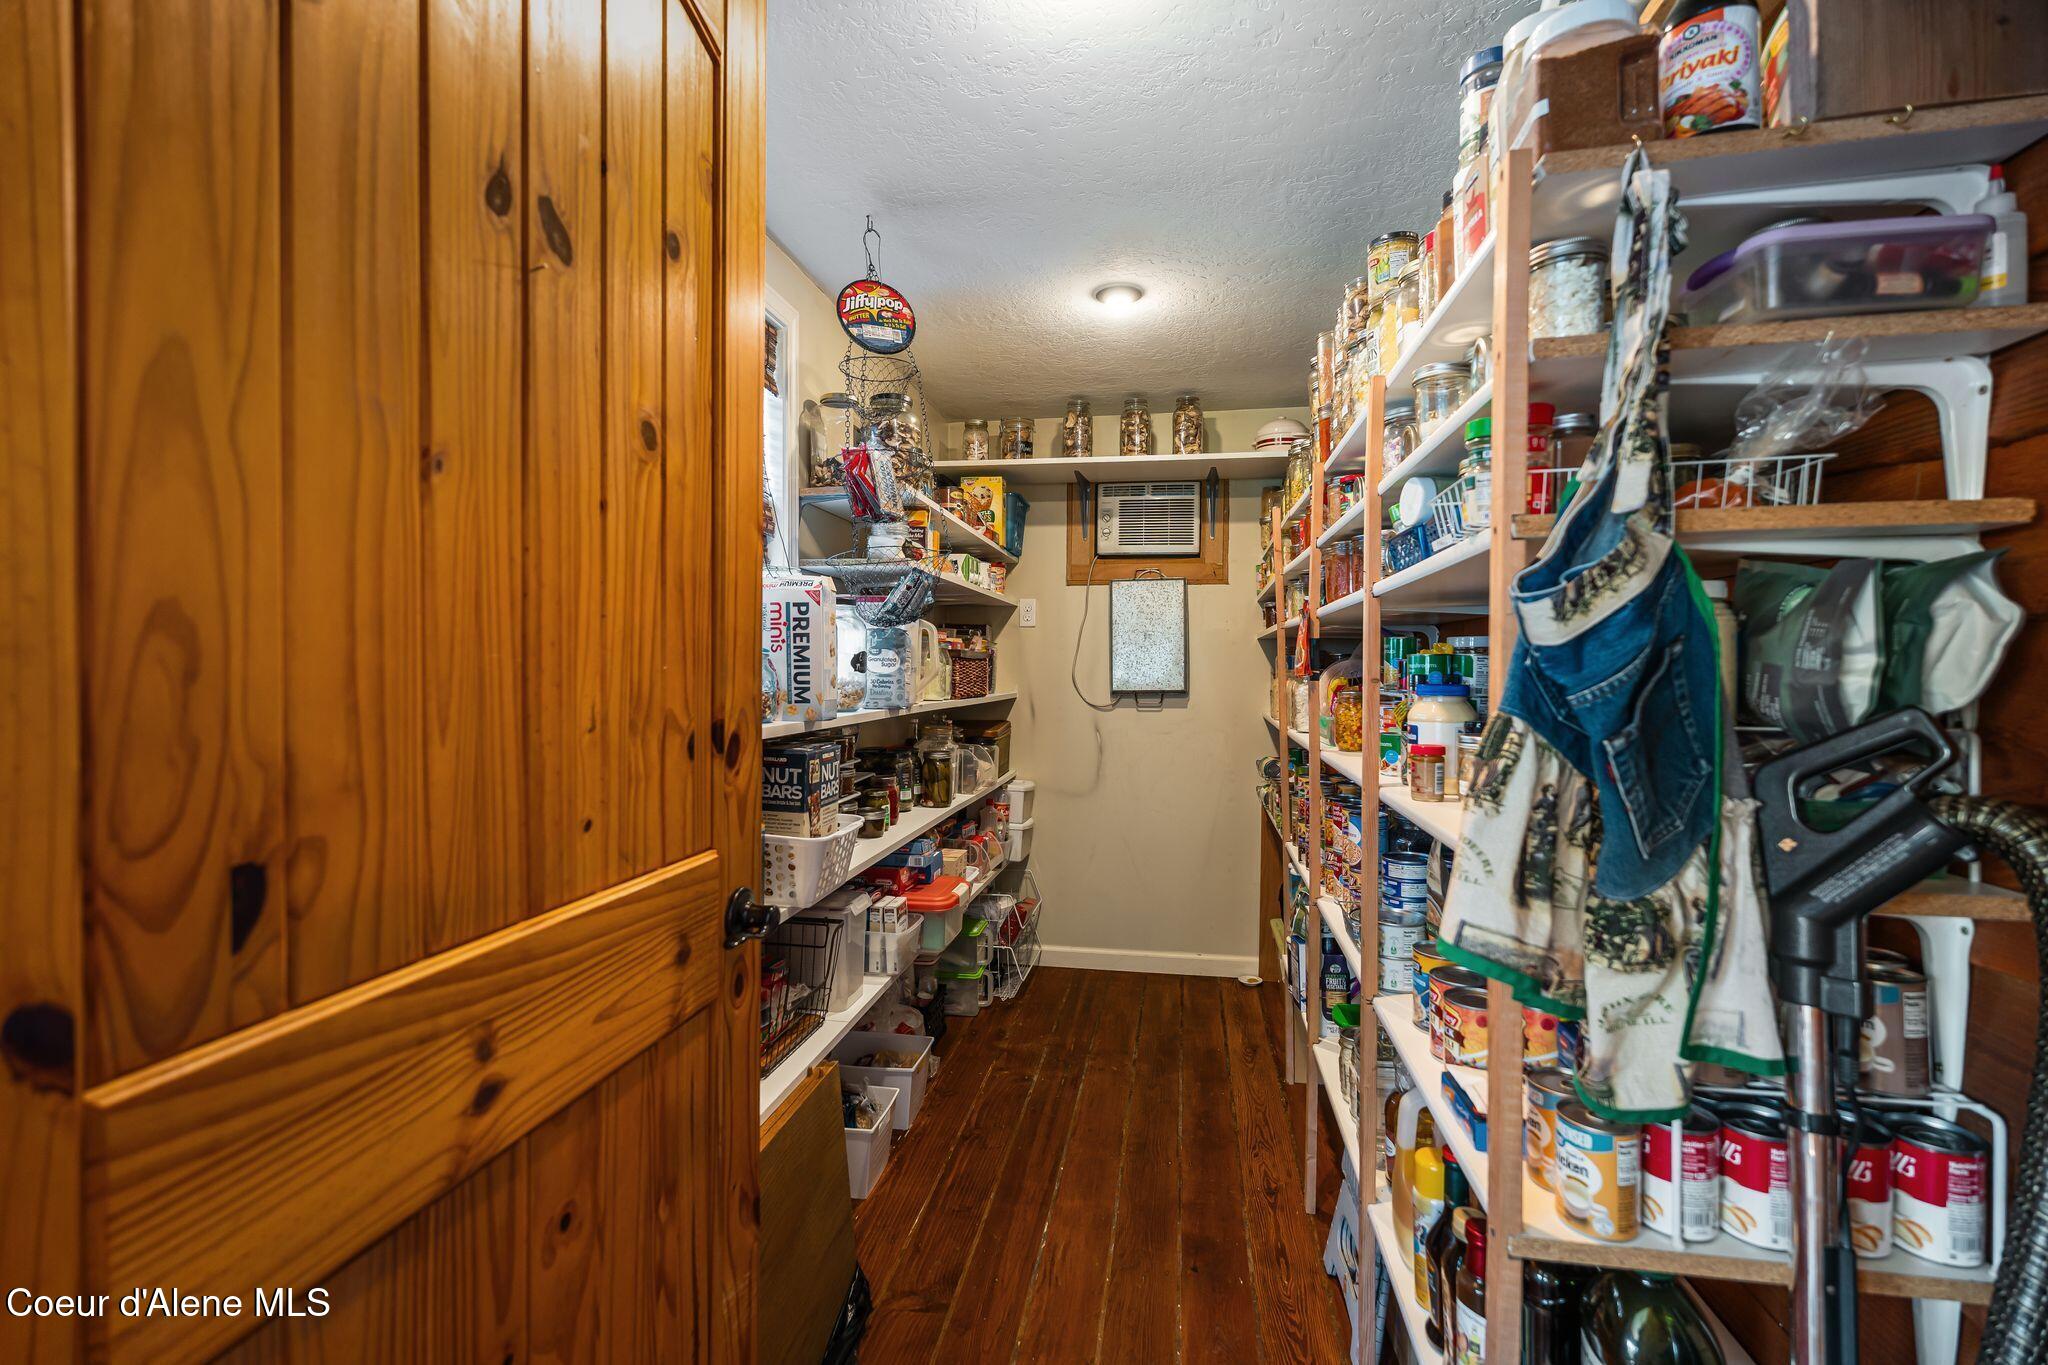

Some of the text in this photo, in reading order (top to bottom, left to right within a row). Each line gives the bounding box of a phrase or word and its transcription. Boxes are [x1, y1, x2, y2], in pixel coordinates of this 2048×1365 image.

[770, 602, 788, 654] minis
[792, 602, 811, 704] PREMIUM
[763, 767, 802, 785] NUT
[821, 760, 840, 782] NUT
[762, 784, 803, 800] BARS
[820, 779, 840, 800] BARS
[1325, 977, 1342, 985] FRUIT
